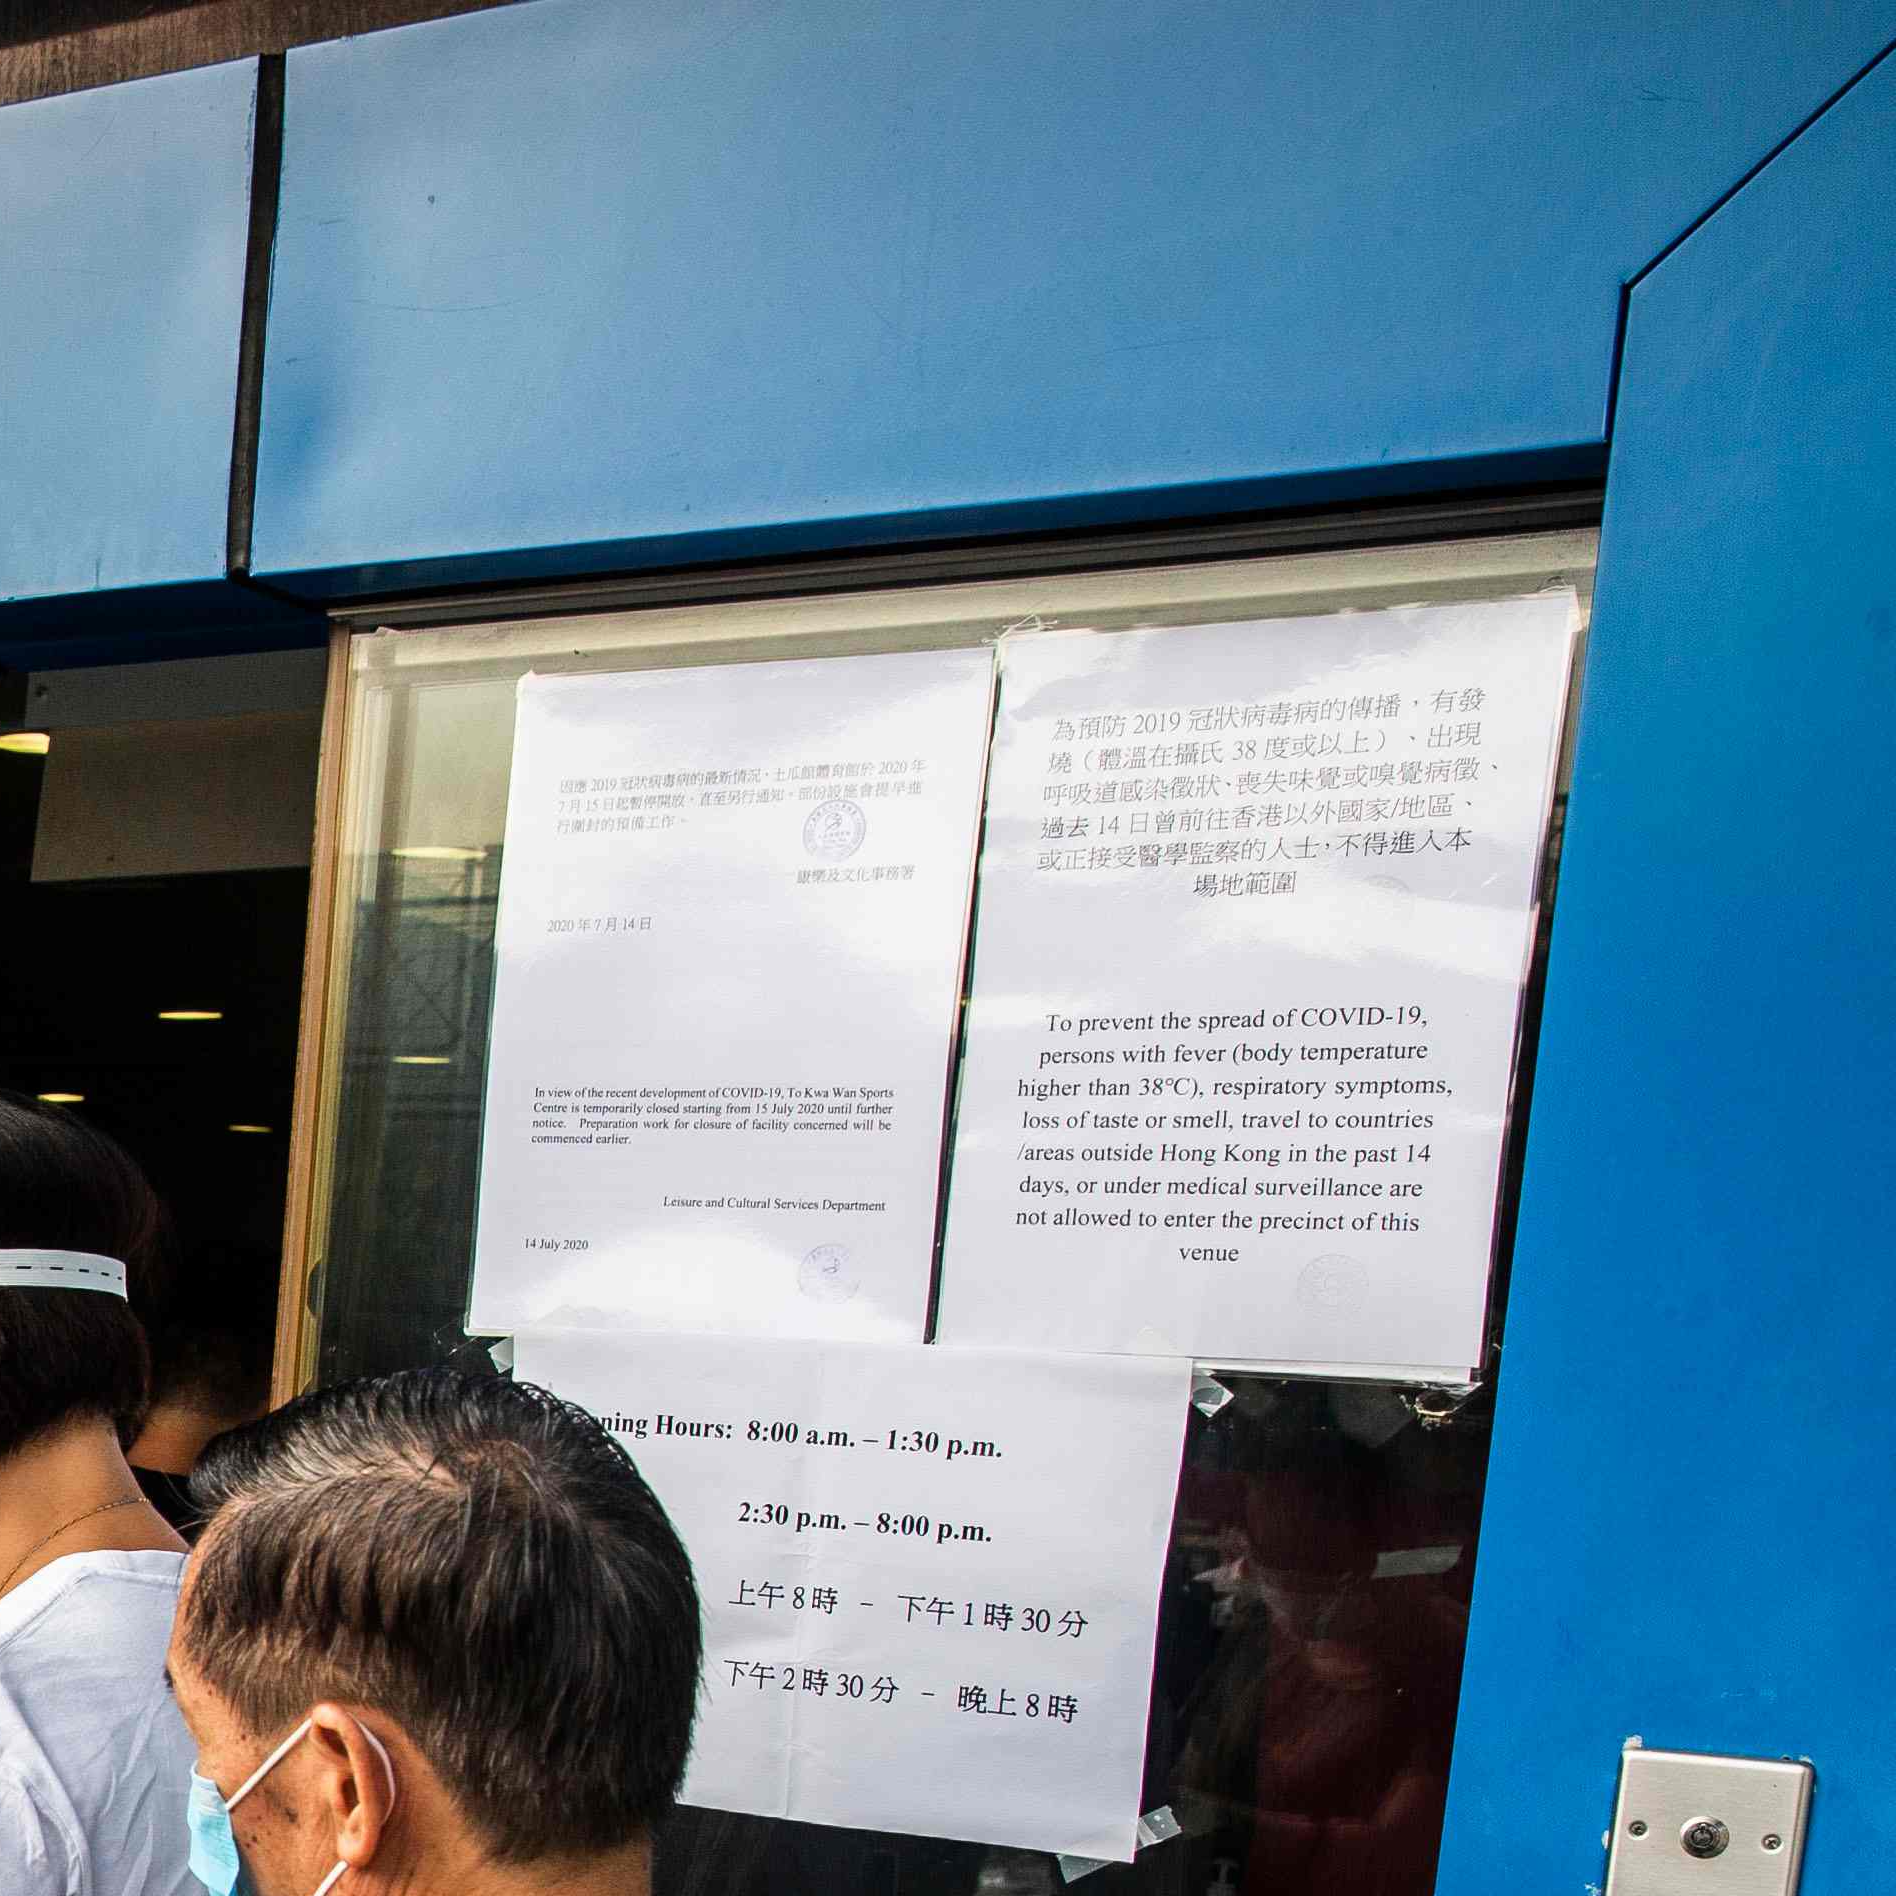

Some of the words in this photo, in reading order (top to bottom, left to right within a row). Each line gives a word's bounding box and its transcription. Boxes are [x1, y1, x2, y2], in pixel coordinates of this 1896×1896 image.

[1046, 1014, 1072, 1032] To
[1077, 1015, 1153, 1036] prevent
[1161, 1011, 1191, 1030] the
[1197, 1008, 1265, 1034] spread
[1272, 1008, 1297, 1028] of
[1301, 1006, 1428, 1027] COVID-19,
[1039, 1050, 1115, 1069] persons
[1122, 1044, 1165, 1063] with
[1173, 1043, 1227, 1062] fever
[1232, 1042, 1293, 1066] (body
[1300, 1043, 1428, 1065] temperature
[534, 1086, 546, 1098] In
[548, 1087, 572, 1098] view
[574, 1086, 587, 1098] of
[588, 1086, 604, 1098] the
[605, 1088, 637, 1098] recent
[639, 1087, 706, 1101] development
[708, 1087, 722, 1098] of
[722, 1087, 784, 1099] COVID-19,
[786, 1087, 802, 1098] To
[803, 1087, 829, 1098] Kwa
[832, 1087, 857, 1098] Wan
[859, 1087, 894, 1101] Sports
[1017, 1078, 1081, 1102] higher
[1088, 1077, 1130, 1096] than
[1138, 1077, 1204, 1099] 38°C),
[1213, 1076, 1327, 1100] respiratory
[1334, 1078, 1452, 1099] symptoms,
[533, 1102, 568, 1113] Centre
[571, 1102, 580, 1113] is
[583, 1102, 644, 1116] temporarily
[646, 1102, 680, 1114] closed
[682, 1102, 722, 1116] starting
[725, 1102, 751, 1114] from
[755, 1103, 768, 1114] 15
[770, 1102, 794, 1116] July
[796, 1103, 824, 1114] 2020
[827, 1103, 852, 1115] until
[856, 1102, 893, 1115] further
[1022, 1110, 1059, 1128] loss
[1066, 1110, 1090, 1128] of
[1093, 1113, 1139, 1128] taste
[1145, 1115, 1167, 1128] or
[1172, 1109, 1233, 1131] smell,
[1242, 1109, 1301, 1128] travel
[1308, 1112, 1328, 1128] to
[1335, 1109, 1433, 1128] countries
[532, 1117, 566, 1128] notice.
[579, 1117, 638, 1131] Preparation
[643, 1117, 669, 1129] work
[673, 1118, 690, 1130] for
[693, 1118, 732, 1130] closure
[735, 1118, 749, 1130] of
[752, 1118, 789, 1133] facility
[793, 1118, 848, 1130] concerned
[852, 1119, 874, 1131] will
[878, 1119, 892, 1131] be
[529, 1132, 593, 1144] commenced
[595, 1133, 631, 1145] earlier.
[1016, 1143, 1074, 1161] /areas
[1081, 1143, 1153, 1162] outside
[1160, 1143, 1217, 1167] Hong
[1224, 1143, 1281, 1167] Kong
[1288, 1143, 1307, 1162] in
[1315, 1143, 1347, 1162] the
[1352, 1147, 1397, 1168] past
[1407, 1143, 1431, 1163] 14
[1019, 1175, 1069, 1198] days,
[1076, 1180, 1098, 1194] or
[1104, 1175, 1162, 1194] under
[1166, 1176, 1247, 1195] medical
[1254, 1177, 1383, 1197] surveillance
[1389, 1183, 1423, 1197] are
[663, 1196, 703, 1207] Leisure
[704, 1196, 725, 1208] and
[727, 1197, 773, 1209] Cultural
[773, 1197, 819, 1210] Services
[821, 1199, 886, 1213] Department
[1015, 1210, 1047, 1225] not
[1052, 1207, 1131, 1227] allowed
[1138, 1212, 1157, 1227] to
[1163, 1212, 1216, 1228] enter
[1222, 1210, 1253, 1229] the
[1258, 1211, 1344, 1234] precinct
[1351, 1211, 1378, 1231] of
[1381, 1212, 1419, 1231] this
[524, 1237, 539, 1250] 14
[539, 1238, 561, 1252] July
[562, 1239, 590, 1251] 2020
[1179, 1247, 1239, 1262] venue
[600, 1412, 648, 1440] ning
[654, 1414, 732, 1439] Hours:
[746, 1420, 798, 1443] 8:00
[805, 1429, 855, 1447] a.m.
[887, 1429, 939, 1453] 1:30
[946, 1439, 1002, 1460] p.m.
[737, 1501, 789, 1525] 2:30
[795, 1511, 846, 1533] p.m.
[876, 1512, 929, 1537] 8:00
[936, 1523, 991, 1544] p.m.
